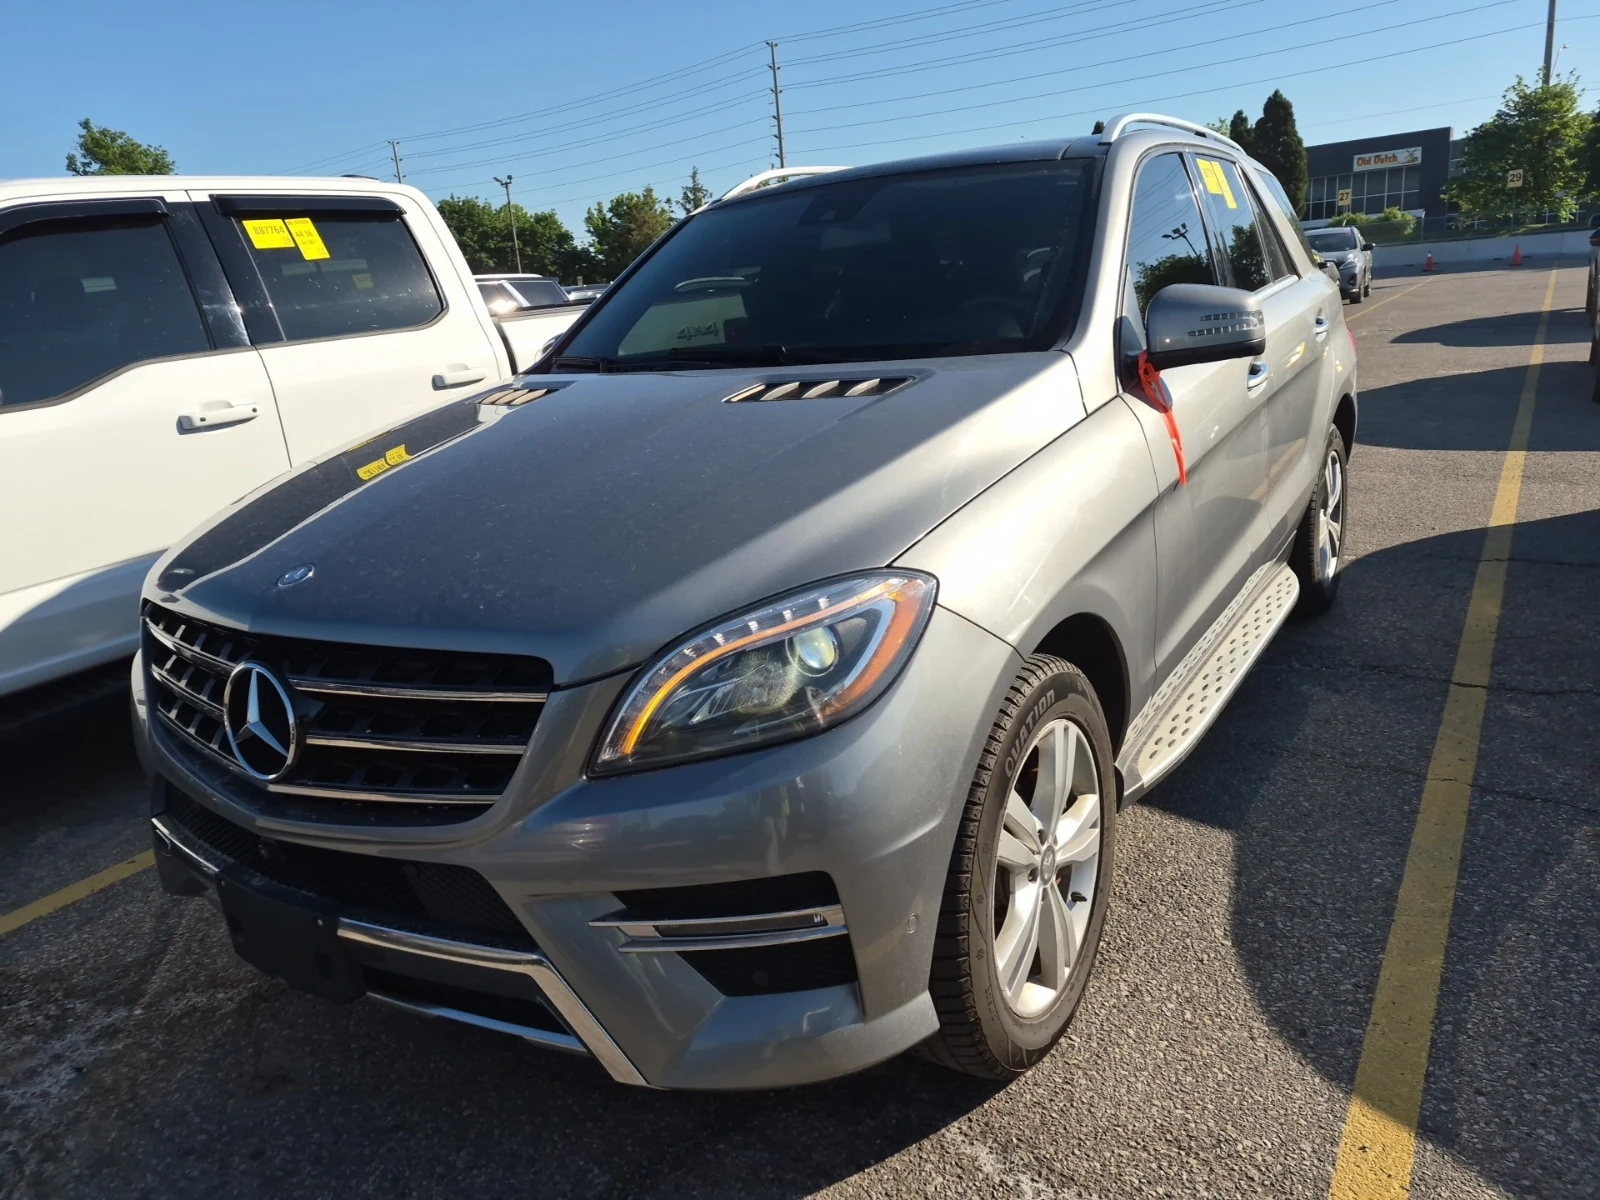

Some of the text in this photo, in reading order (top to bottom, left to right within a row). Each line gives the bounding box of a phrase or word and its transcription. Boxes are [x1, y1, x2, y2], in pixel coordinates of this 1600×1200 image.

[1356, 153, 1398, 167] Old Dutch
[1509, 172, 1522, 183] 29
[1339, 192, 1349, 201] 27
[253, 226, 285, 235] 887764
